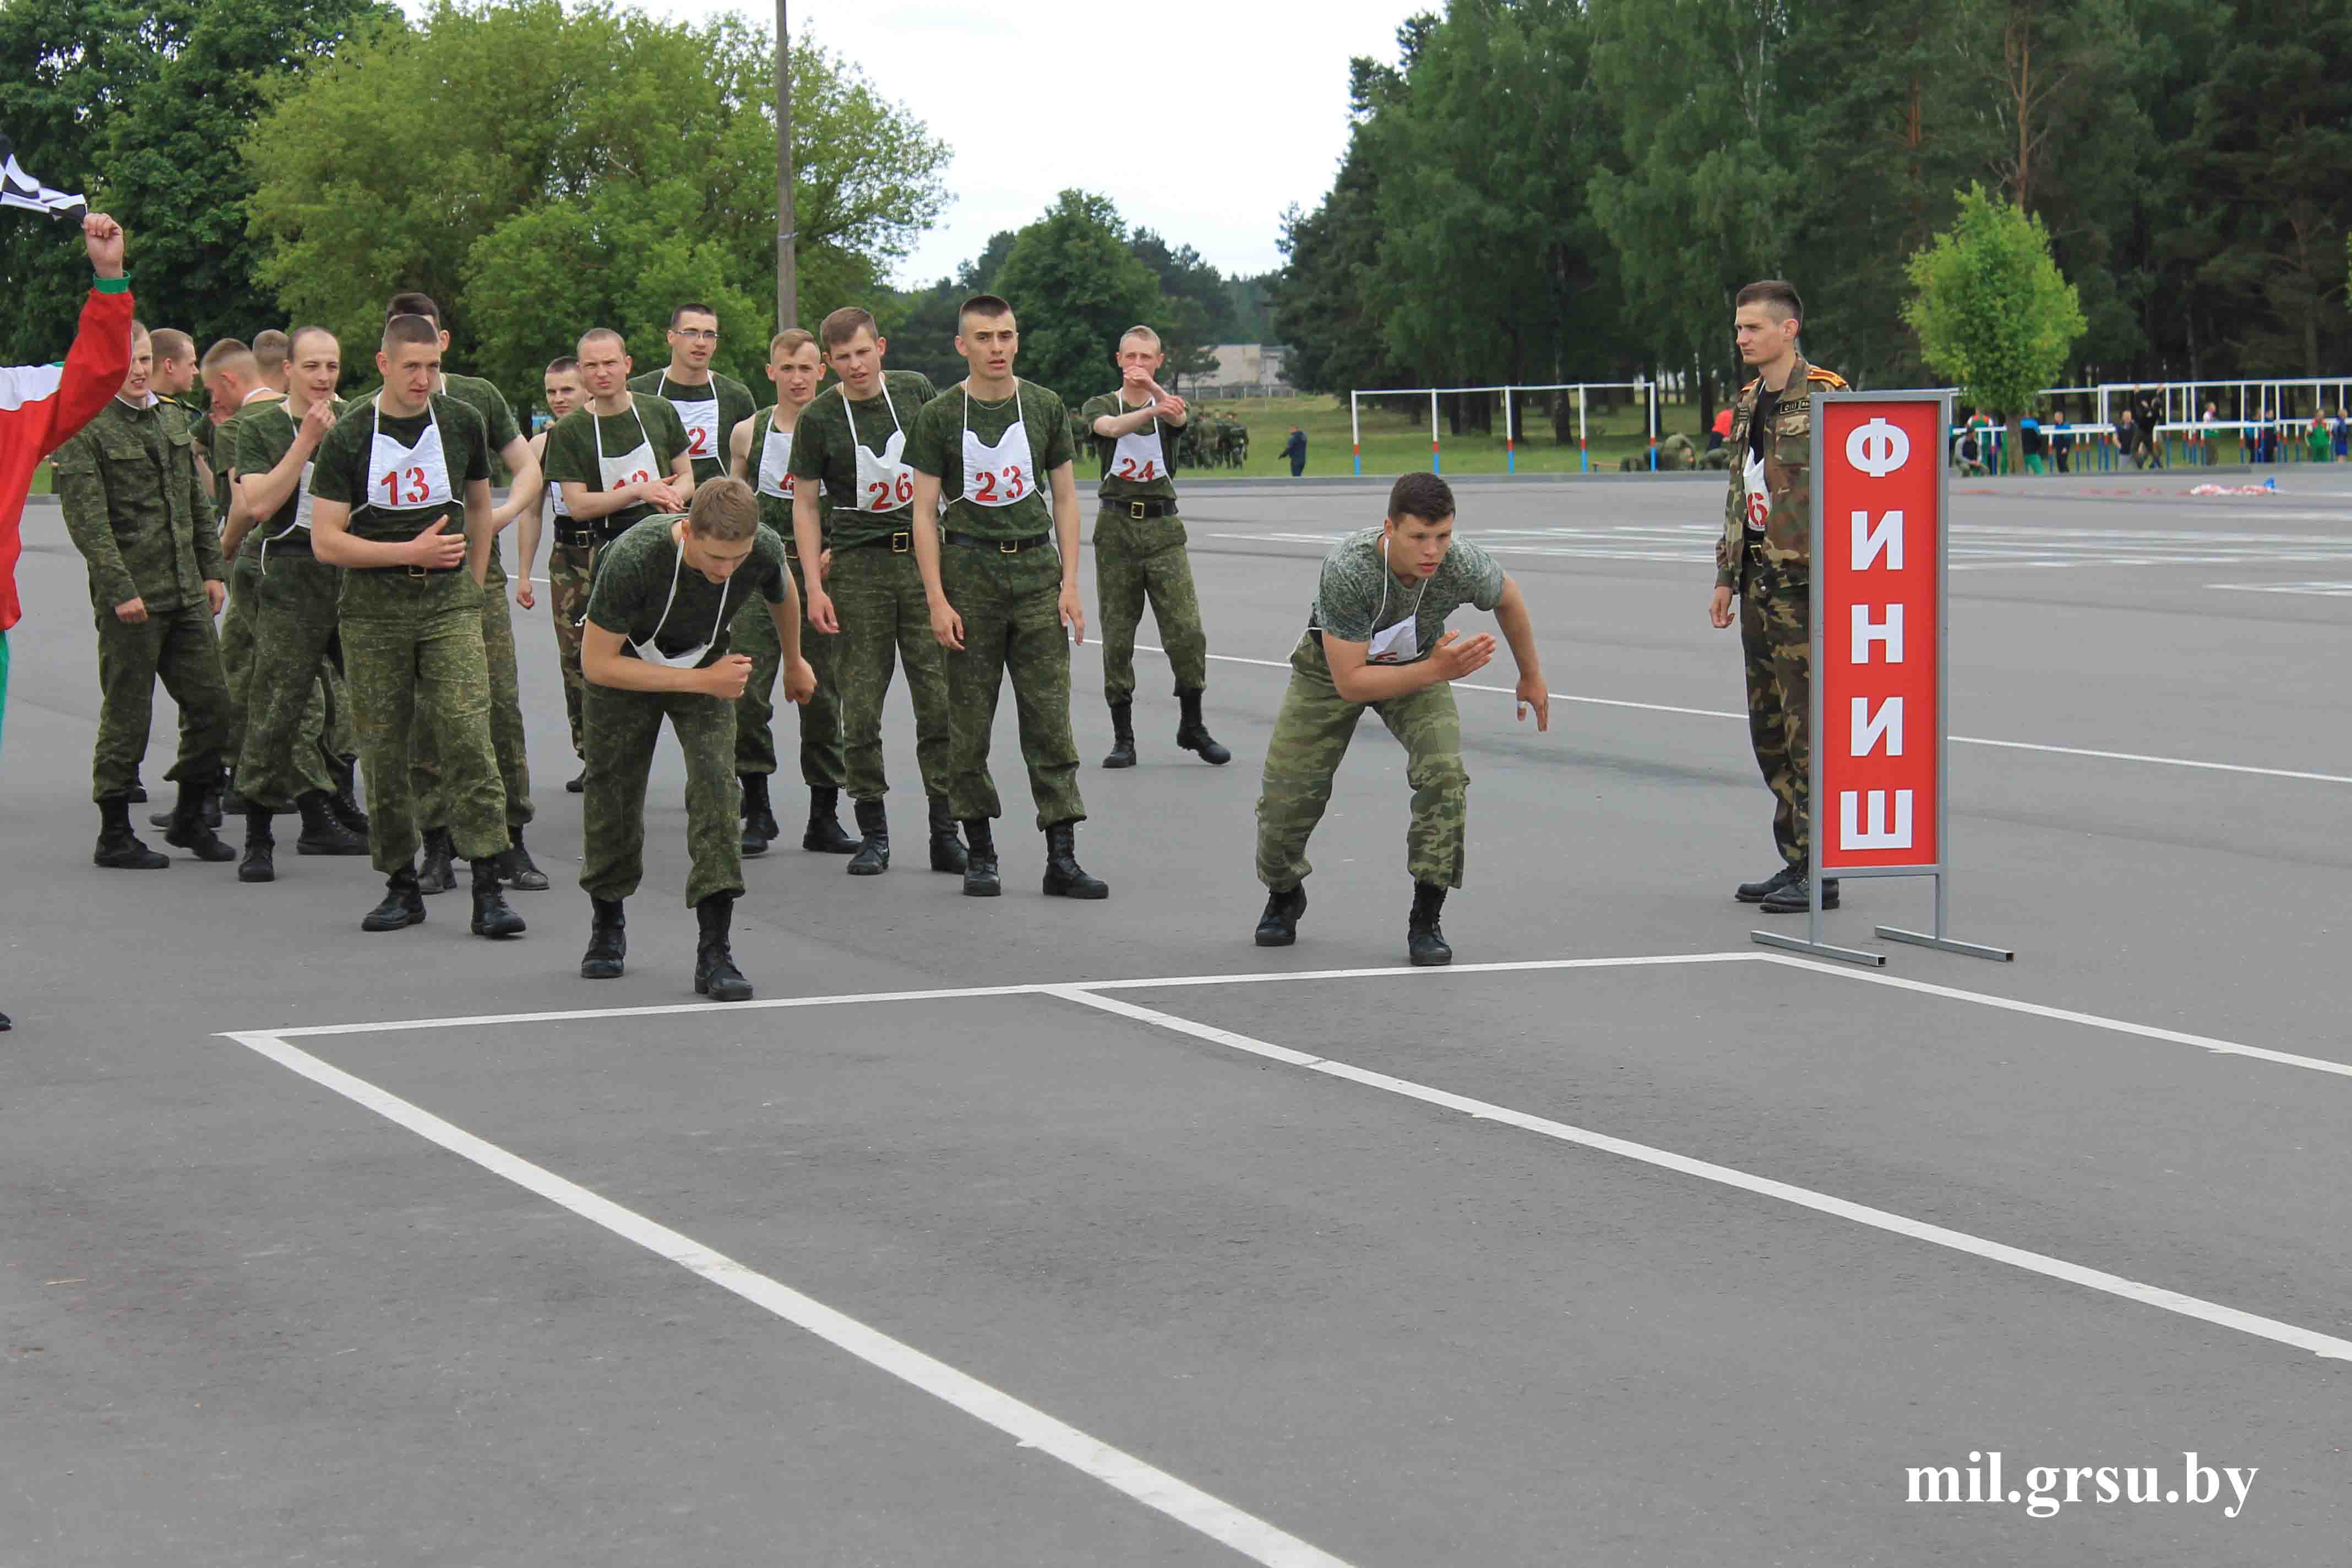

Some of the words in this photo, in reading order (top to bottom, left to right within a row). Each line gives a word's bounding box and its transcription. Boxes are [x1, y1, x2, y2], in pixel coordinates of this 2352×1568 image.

[380, 466, 430, 506] 13
[976, 466, 1023, 502] 23
[1118, 458, 1155, 481] 24
[868, 473, 914, 510] 26
[1839, 417, 1913, 851] ФИНИШ
